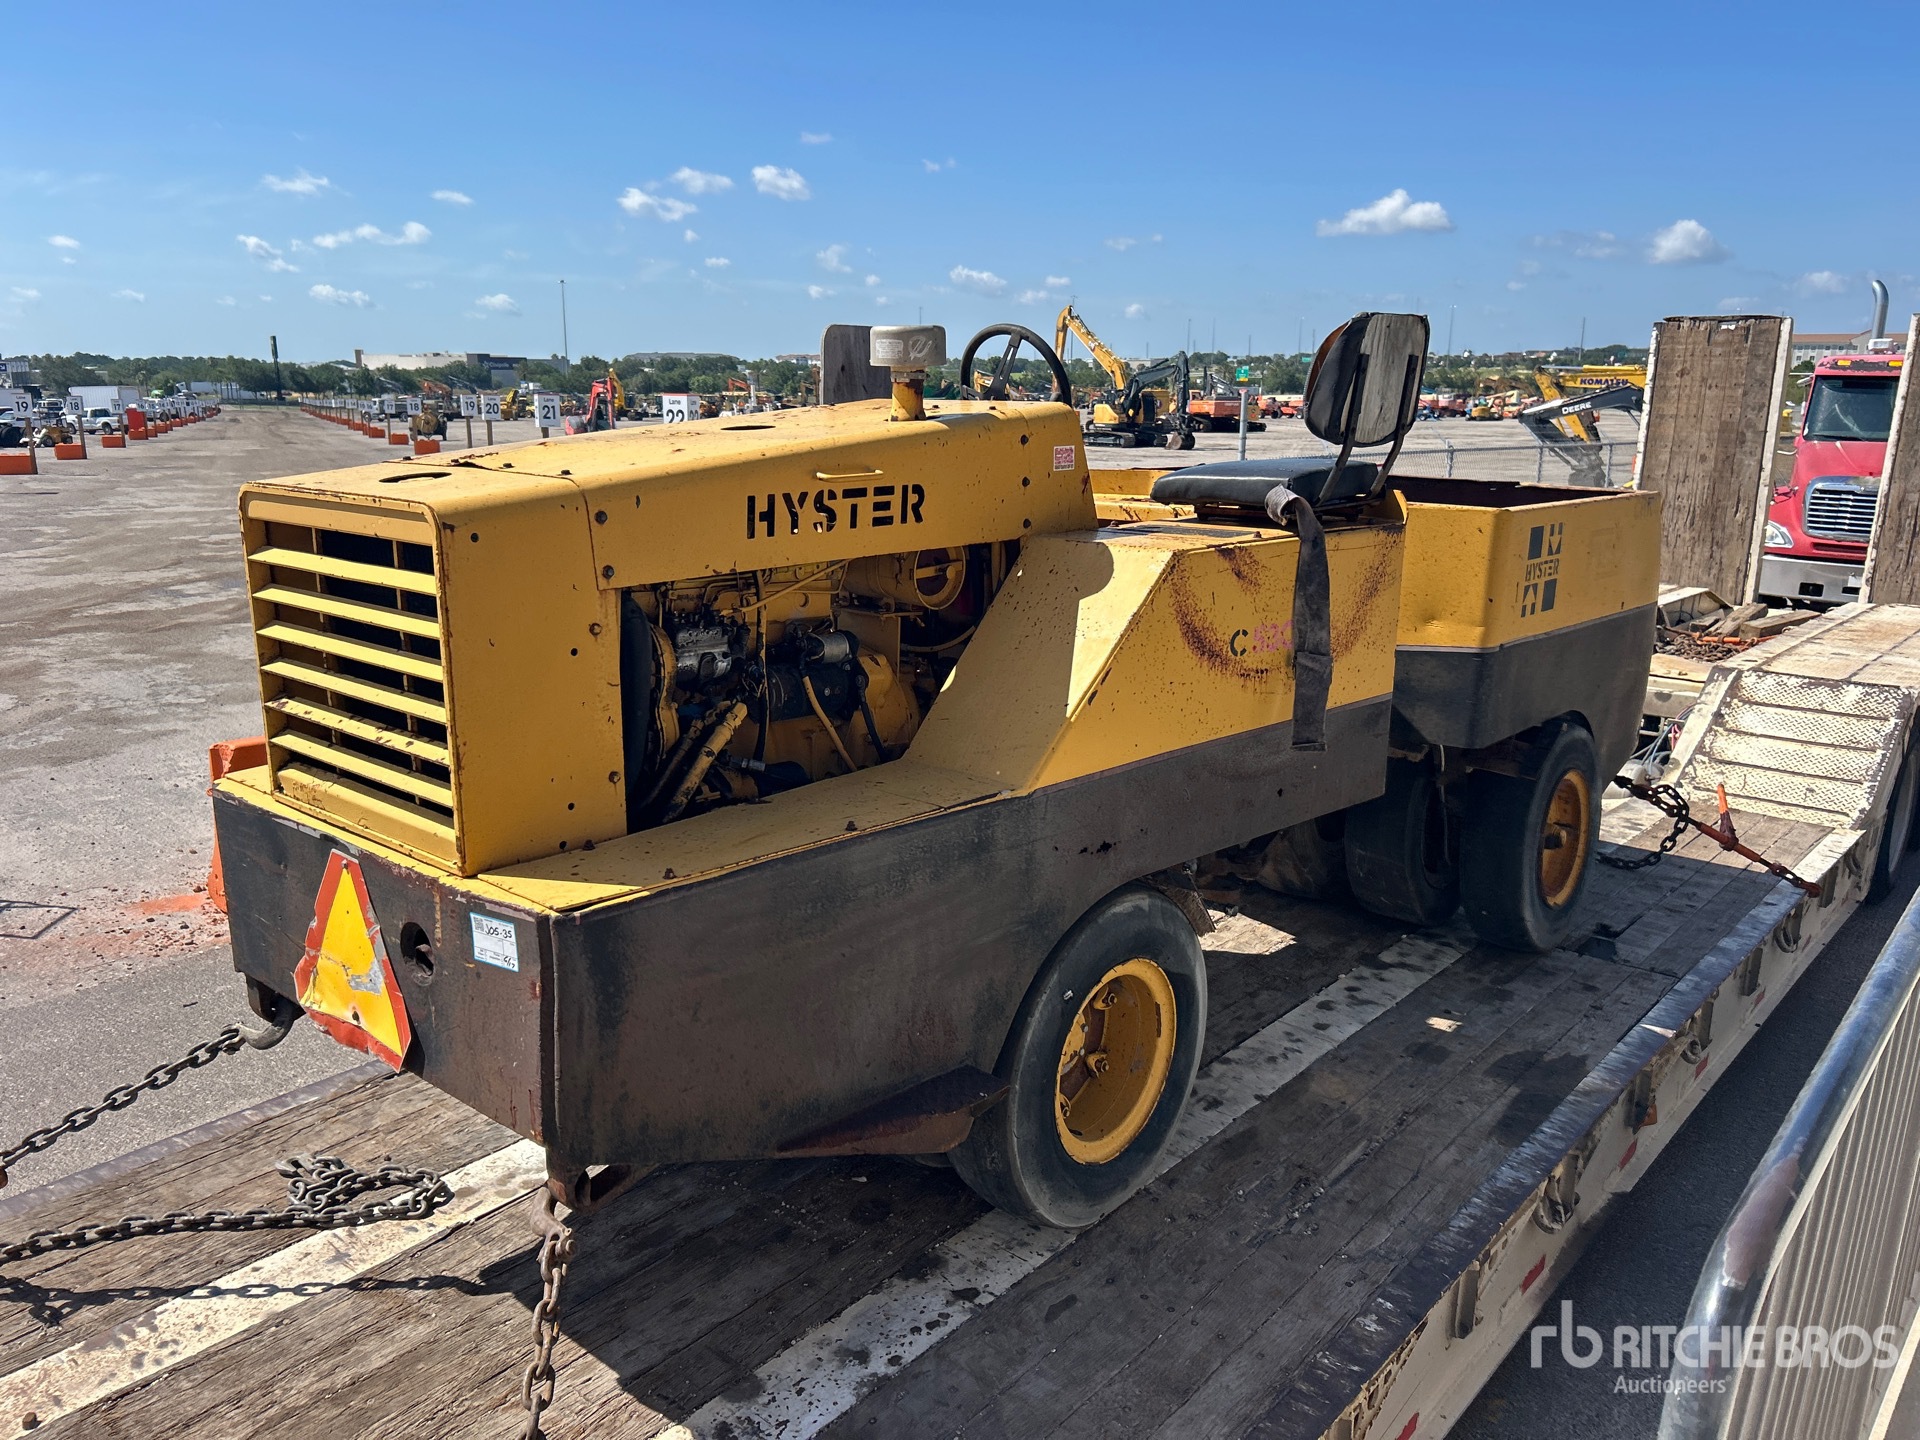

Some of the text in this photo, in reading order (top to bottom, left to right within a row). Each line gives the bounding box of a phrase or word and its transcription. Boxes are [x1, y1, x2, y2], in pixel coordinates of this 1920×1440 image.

[1580, 378, 1629, 386] KOMATSU
[15, 401, 29, 412] 19
[69, 402, 79, 411] 18
[409, 403, 419, 411] 18
[464, 401, 475, 411] 19
[485, 403, 499, 414] 20
[1562, 402, 1592, 415] DEERE
[542, 405, 557, 419] 21
[666, 409, 685, 423] 22
[747, 484, 925, 539] HYSTER
[1525, 558, 1560, 582] HYSTER
